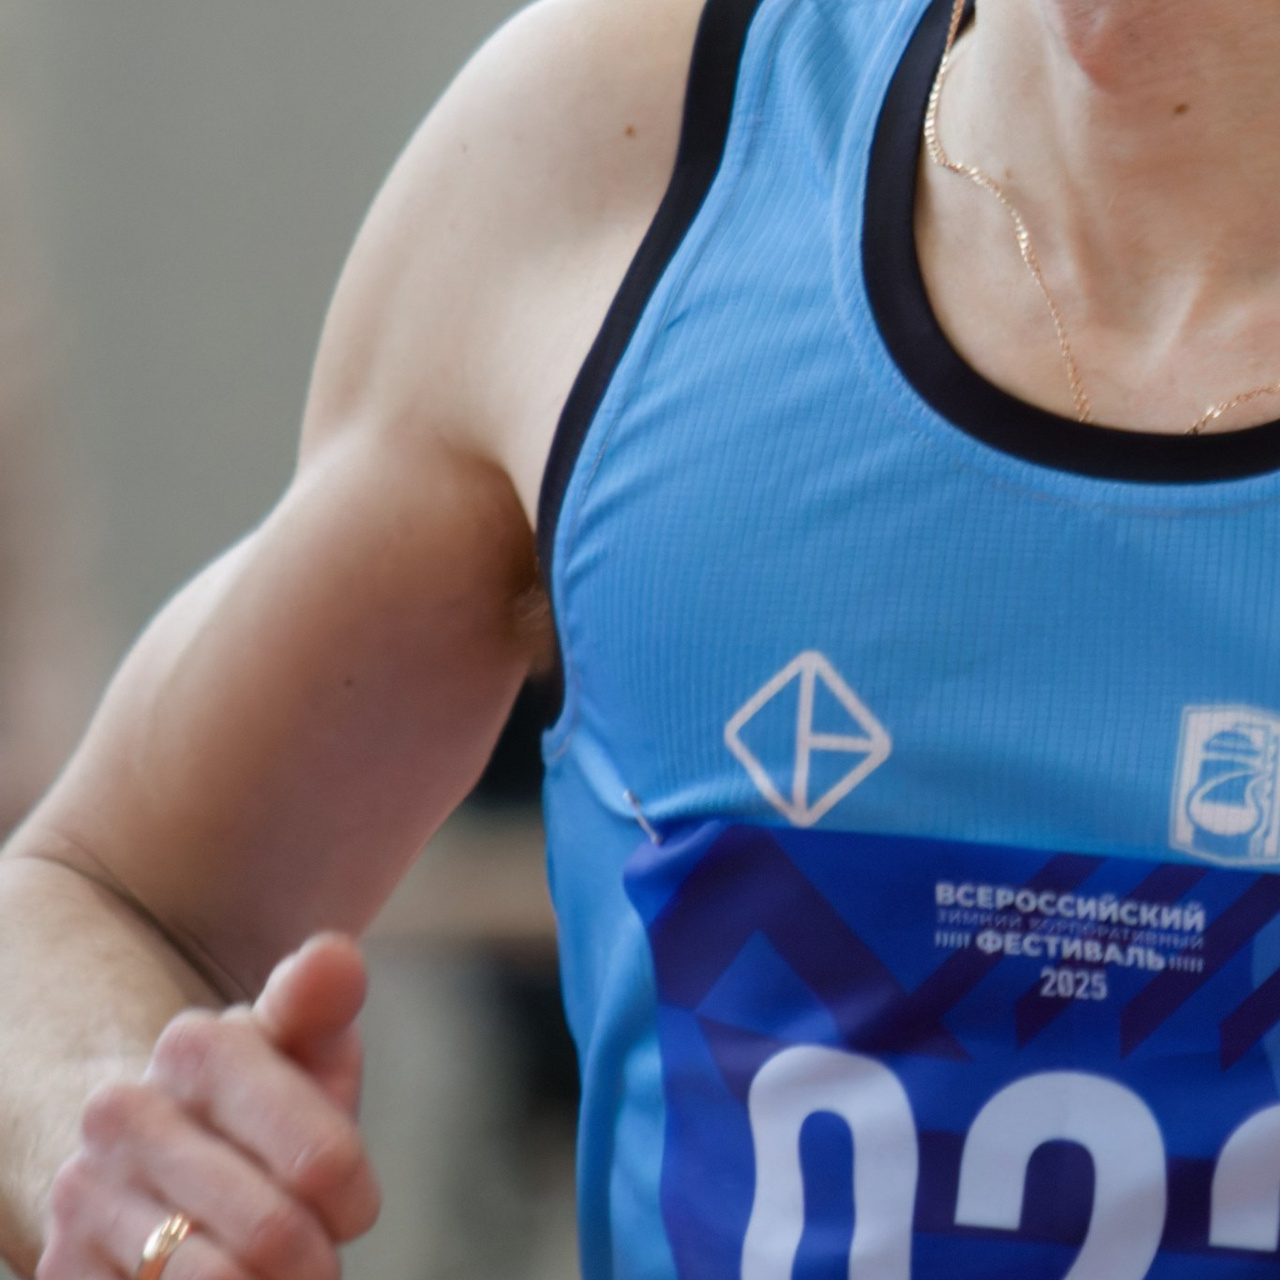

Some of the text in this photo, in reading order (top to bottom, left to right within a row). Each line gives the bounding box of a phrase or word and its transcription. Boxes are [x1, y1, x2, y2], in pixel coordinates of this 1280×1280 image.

[934, 881, 1206, 933] ВСЕРОССИЙСКИЙ
[975, 928, 1166, 971] ФЕСТИВАЛЬ
[1039, 967, 1109, 1001] 2025
